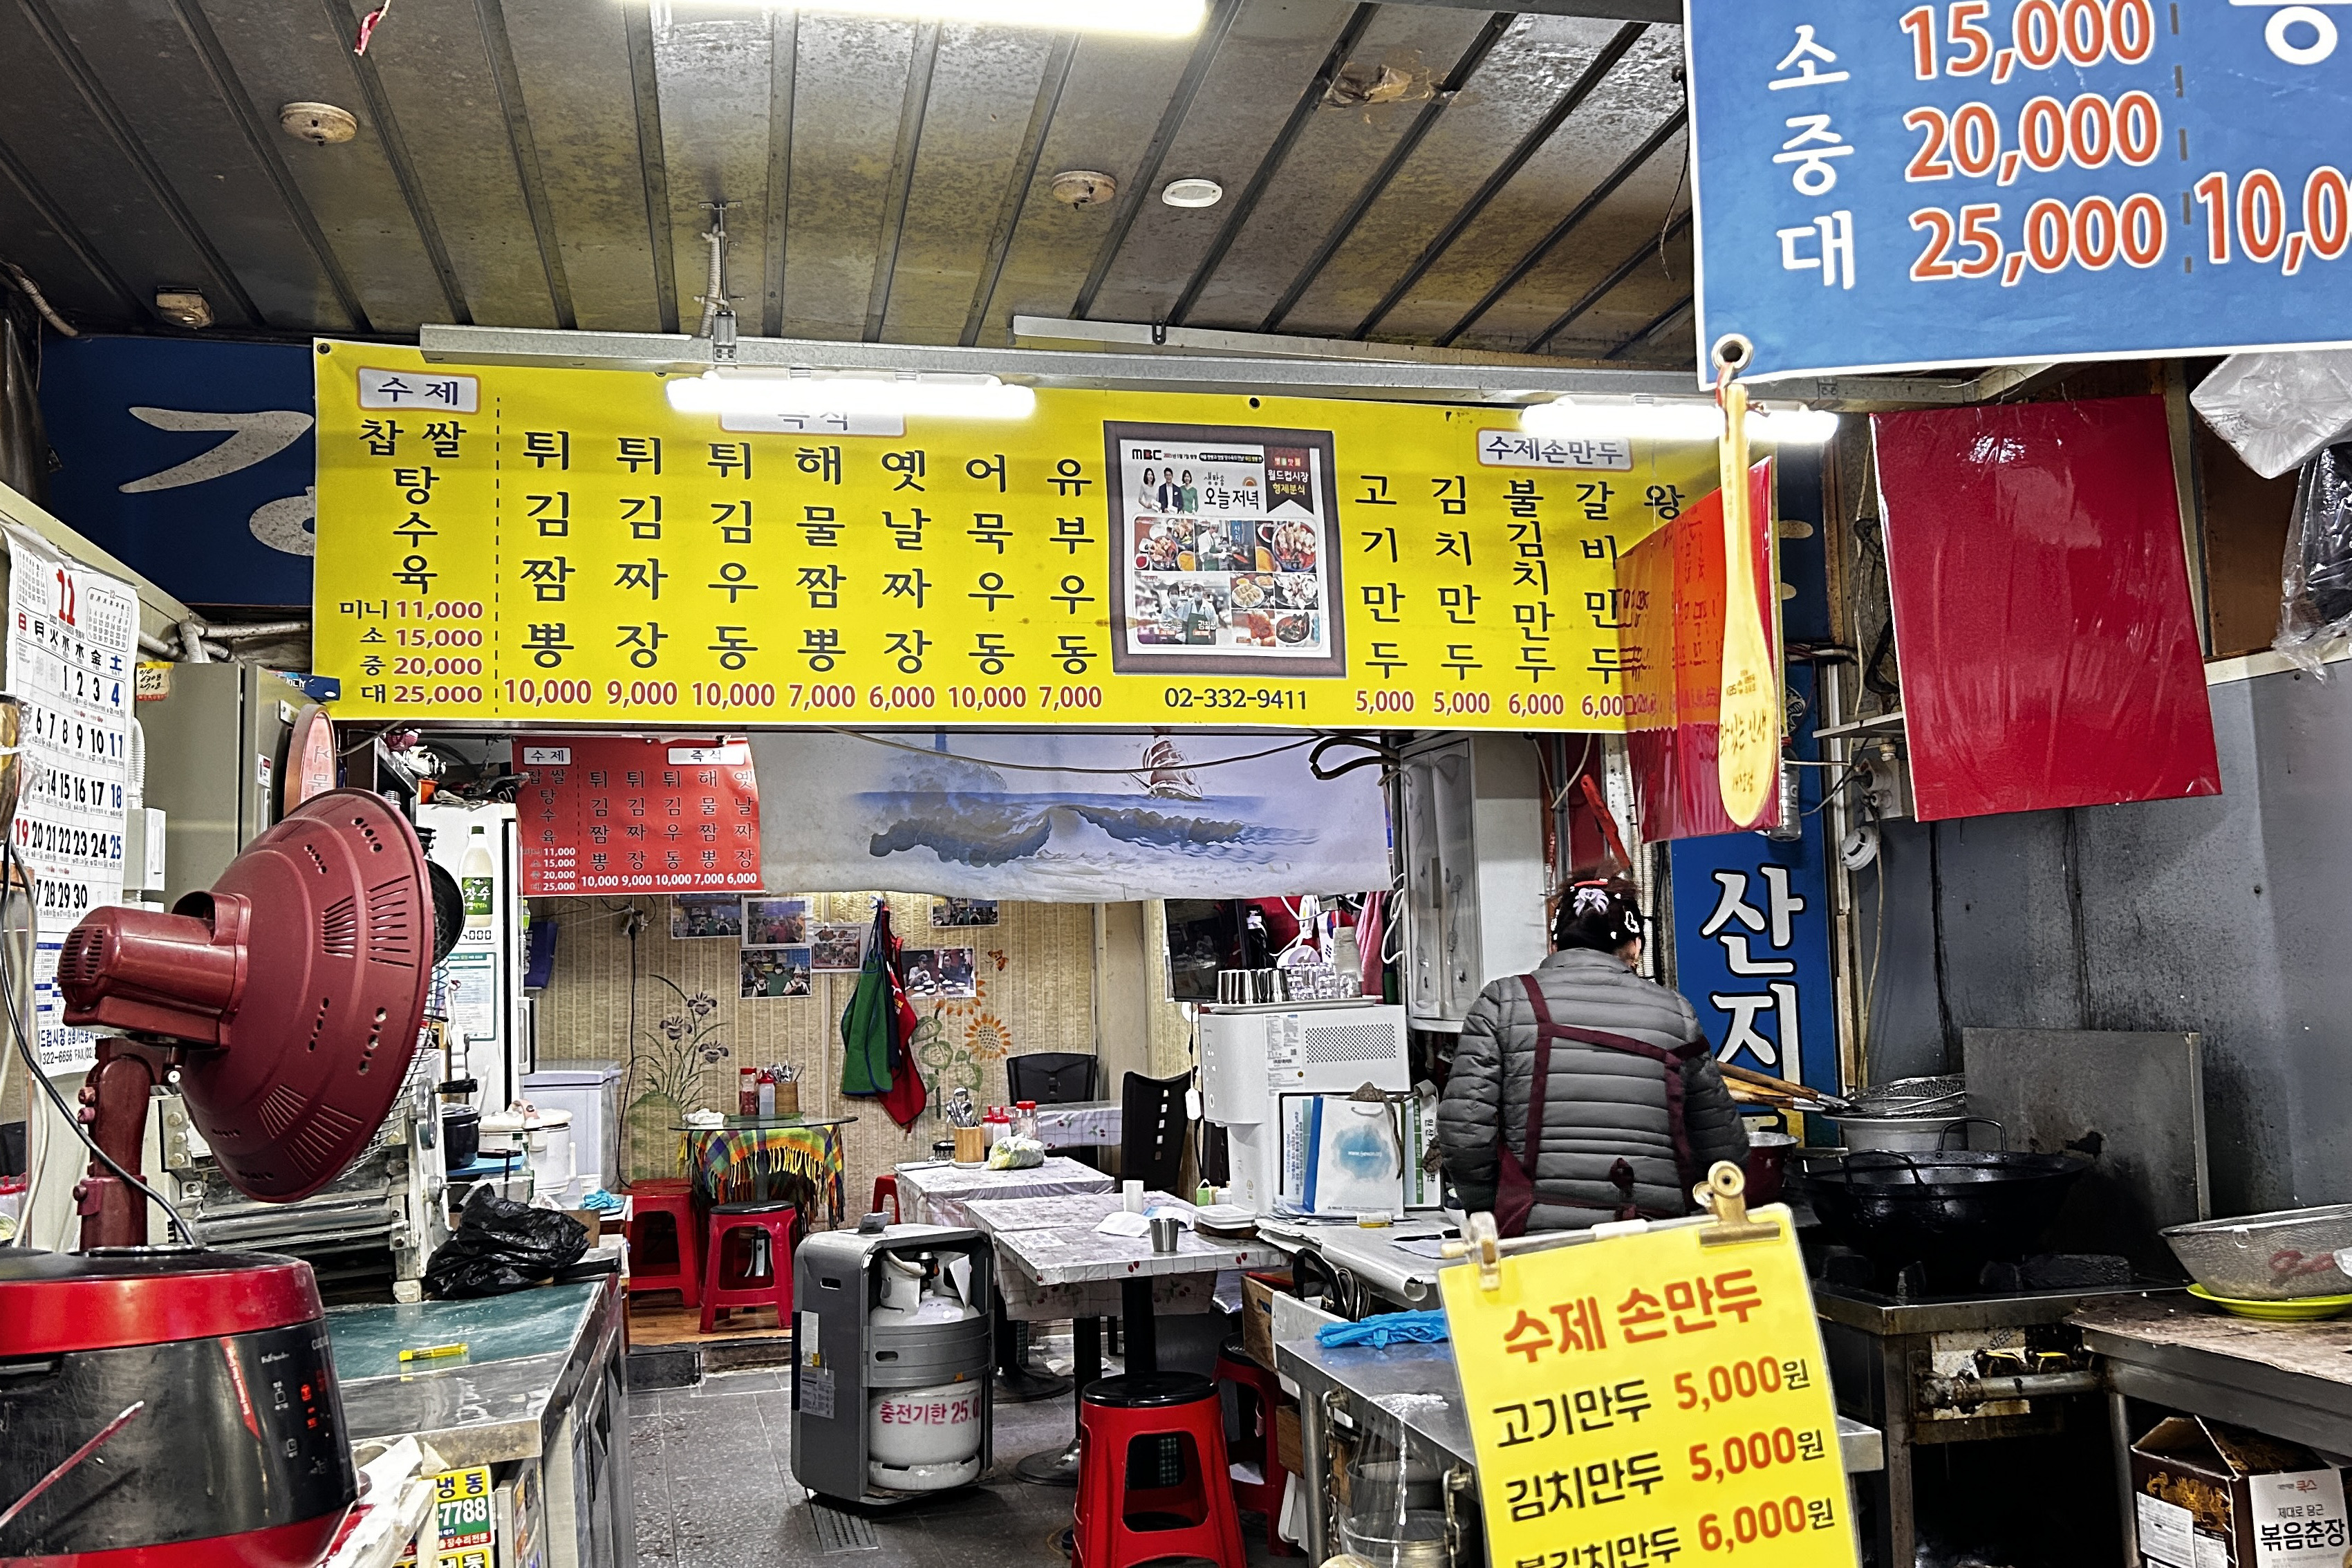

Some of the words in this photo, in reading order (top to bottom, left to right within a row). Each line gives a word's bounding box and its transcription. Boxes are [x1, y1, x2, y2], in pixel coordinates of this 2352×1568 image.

[1768, 24, 1849, 91] 소
[1900, 0, 2156, 84] 15,000
[1773, 114, 1854, 198] 중
[1903, 90, 2161, 186] 20,000
[1776, 210, 1855, 290] 대
[1908, 192, 2167, 288] 25,000
[2194, 166, 2352, 275] 10,0
[377, 377, 458, 406] 수제
[358, 419, 467, 458] 찹쌀
[1132, 449, 1163, 460] MBC
[1486, 436, 1623, 465] 수제손만두
[1267, 469, 1309, 483] 월드컵시장
[1272, 482, 1306, 496] 형제분식
[1204, 487, 1260, 510] 오늘저녁
[392, 466, 440, 595] 탕수육
[520, 431, 576, 669] 튀김짬뽕
[613, 437, 669, 669] 튀김짜장
[707, 442, 759, 671] 튀김우동
[794, 446, 847, 672] 해물짬뽕
[881, 449, 933, 674] 옛날짜장
[966, 454, 1015, 675] 어묵우동
[1047, 458, 1098, 675] 유부우동
[56, 568, 76, 626] 11
[1354, 475, 1408, 680] 고기만두
[1431, 475, 1483, 681] 김치만두
[1502, 479, 1556, 684] 불김치만두
[339, 599, 388, 619] 미니
[396, 601, 483, 621] 11,000
[19, 612, 26, 631] 日
[35, 620, 44, 638] 月
[50, 628, 59, 646] 火
[62, 635, 70, 652] 水
[75, 643, 84, 659] 木
[91, 649, 102, 666] 金
[110, 655, 122, 671] 土
[360, 627, 386, 643] 소
[396, 629, 483, 649] 15,000
[64, 665, 68, 691] 1
[77, 671, 84, 697] 2
[93, 677, 100, 702] 3
[111, 682, 120, 707] 4
[360, 655, 386, 676] 중
[393, 657, 482, 678] 20,000
[360, 684, 386, 704] 대
[393, 685, 483, 705] 25,000
[505, 679, 592, 707] 10,000
[607, 680, 678, 709] 9,000
[692, 682, 775, 710] 10,000
[790, 684, 855, 711] 7,000
[870, 686, 935, 711] 6,000
[949, 687, 1026, 711] 10,000
[1039, 686, 1102, 711] 7,000
[1164, 687, 1306, 710] 02-332-9411
[1356, 691, 1414, 714] 5,000
[1434, 692, 1490, 716] 5,000
[1509, 693, 1564, 717] 6,000
[37, 708, 42, 734] 6
[50, 713, 55, 739] 7
[63, 719, 68, 744] 8
[77, 724, 83, 749] 9
[91, 728, 104, 754] 10
[109, 733, 123, 758] 11
[531, 750, 565, 763] 수제
[60, 773, 70, 799] 15
[74, 777, 86, 803] 16
[91, 781, 104, 806] 17
[111, 784, 122, 809] 18
[15, 818, 29, 847] 19
[32, 821, 43, 849] 20
[46, 825, 56, 852] 21
[59, 827, 71, 854] 22
[73, 830, 87, 857] 23
[91, 833, 107, 859] 24
[110, 834, 122, 859] 25
[540, 789, 557, 846] 탕수육
[590, 770, 610, 872] 튀김짬뽕
[626, 770, 646, 870] 튀김짜장
[663, 770, 683, 870] 튀김우동
[698, 770, 718, 869] 해물짬뽕
[734, 770, 755, 868] 옛날짜장
[544, 848, 575, 857] 11,000
[544, 859, 575, 868] 15,000
[36, 879, 41, 906] 7
[44, 880, 55, 908] 28
[58, 882, 70, 908] 29
[73, 884, 88, 909] 30
[543, 871, 575, 879] 20,000
[543, 882, 575, 891] 25,000
[581, 876, 618, 888] 10,000
[622, 875, 652, 887] 9,000
[656, 874, 691, 886] 10,000
[695, 874, 724, 885] 7,000
[727, 873, 756, 885] 6,000
[39, 1028, 66, 1047] 드컵시장
[1503, 1296, 1607, 1363] 수제
[1618, 1269, 1762, 1344] 손만두
[880, 1401, 947, 1425] 충전기한
[1493, 1379, 1652, 1448] 고기만두
[1674, 1355, 1811, 1412] 5,000원
[437, 1472, 484, 1499] 냉동
[1506, 1450, 1663, 1523] 김치만두
[1689, 1426, 1825, 1484] 5,000원
[1698, 1495, 1836, 1554] 6,000원
[2277, 1506, 2304, 1518] 제대로
[2261, 1518, 2345, 1551] 볶음춘장
